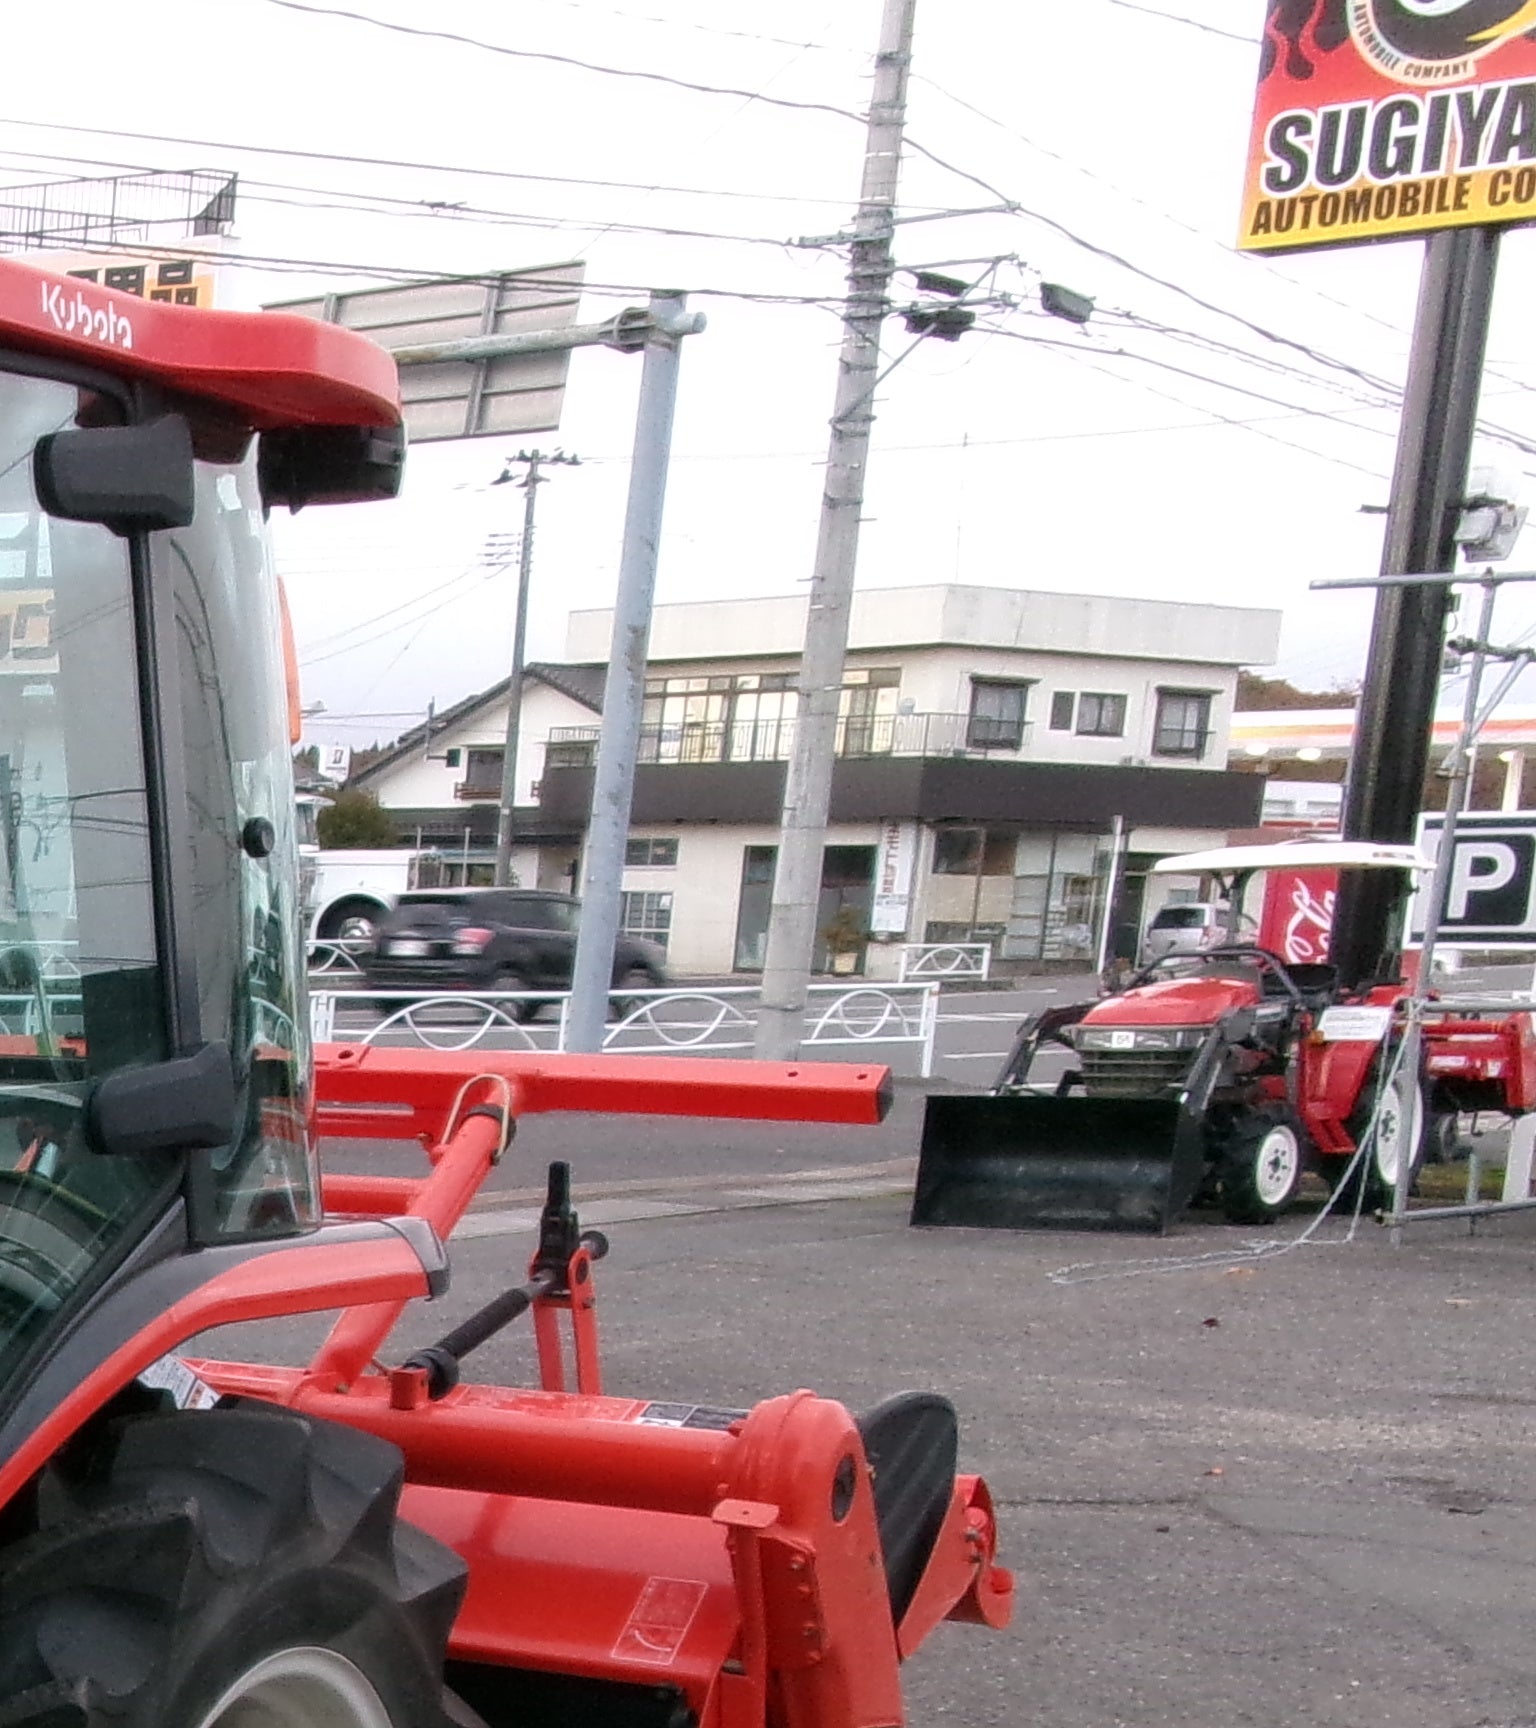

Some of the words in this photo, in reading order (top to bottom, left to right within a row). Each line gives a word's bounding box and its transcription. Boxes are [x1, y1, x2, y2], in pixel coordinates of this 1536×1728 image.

[1403, 60, 1469, 78] COMPANY
[1250, 175, 1473, 236] AUTOMOBILE
[41, 280, 133, 349] Kubota
[1446, 842, 1517, 920] P
